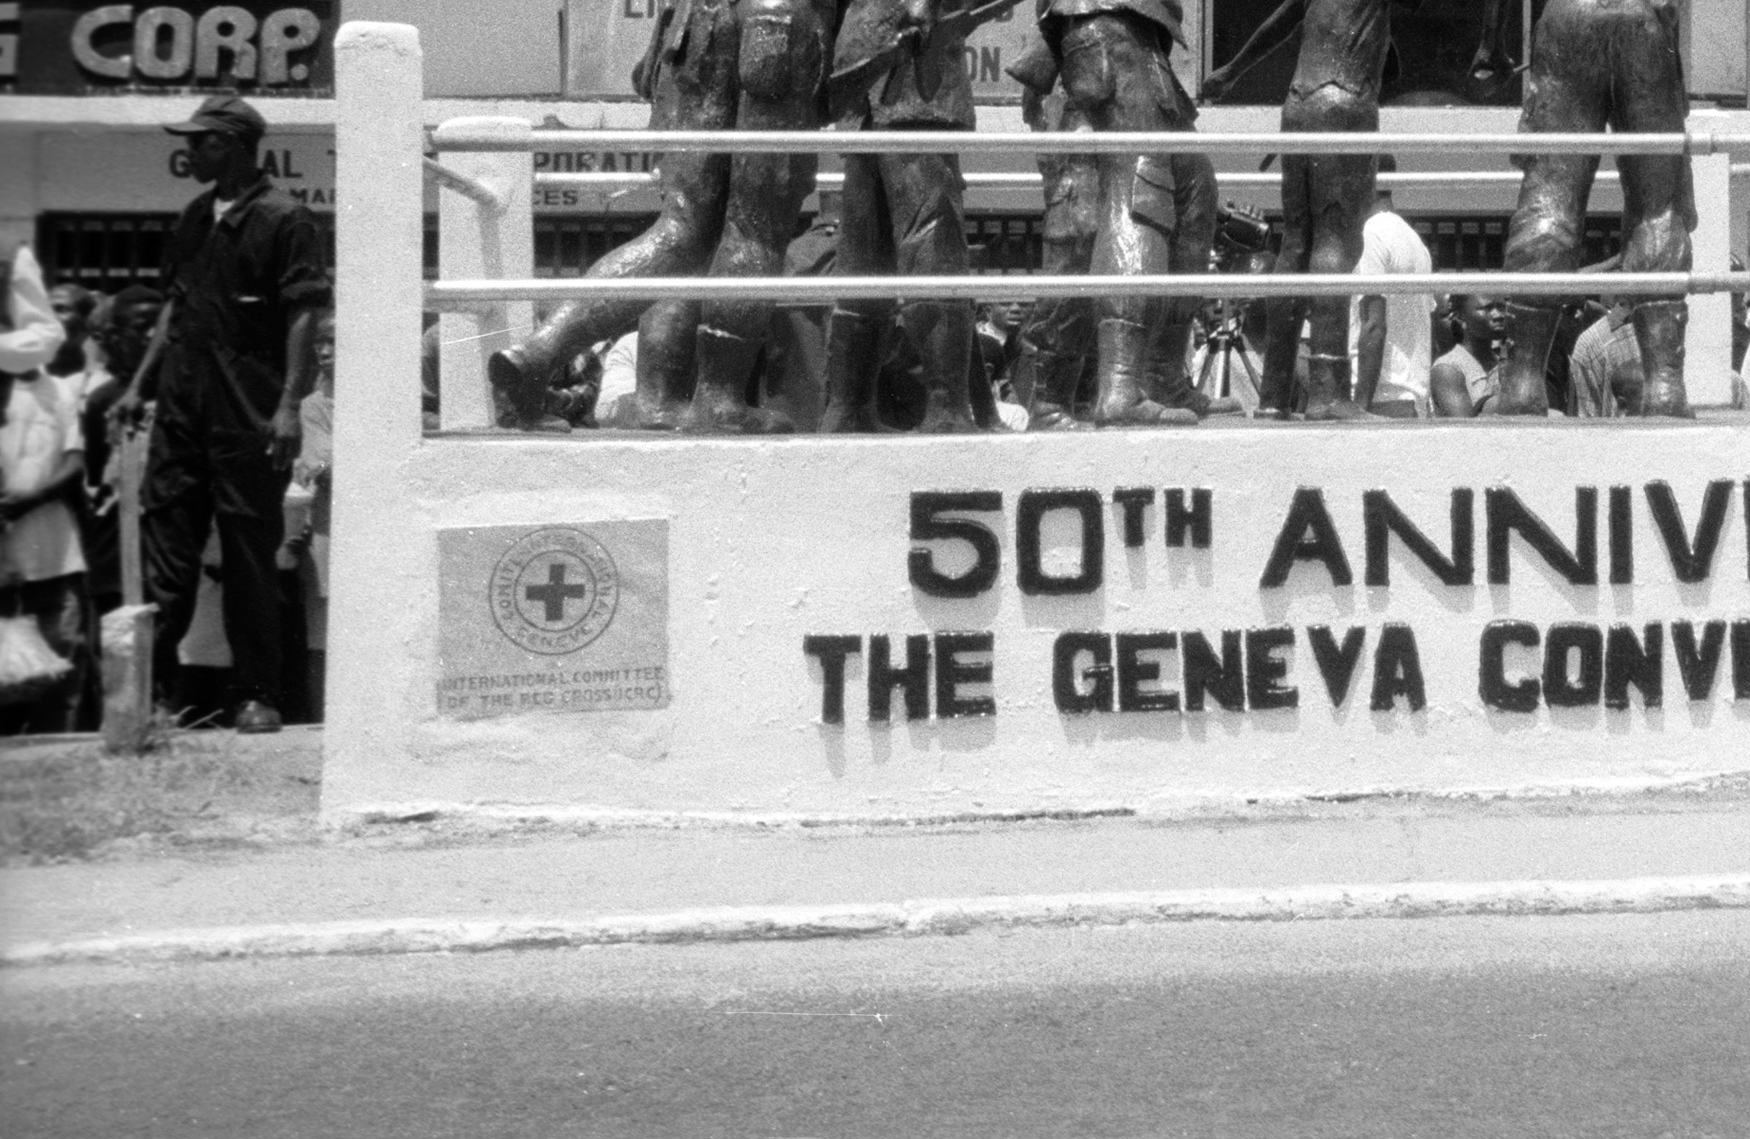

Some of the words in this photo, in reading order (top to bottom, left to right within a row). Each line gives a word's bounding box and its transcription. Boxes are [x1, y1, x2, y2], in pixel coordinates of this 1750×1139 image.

[71, 4, 321, 83] CORP.
[803, 630, 998, 723] THE
[1052, 624, 1428, 715] GENEVA
